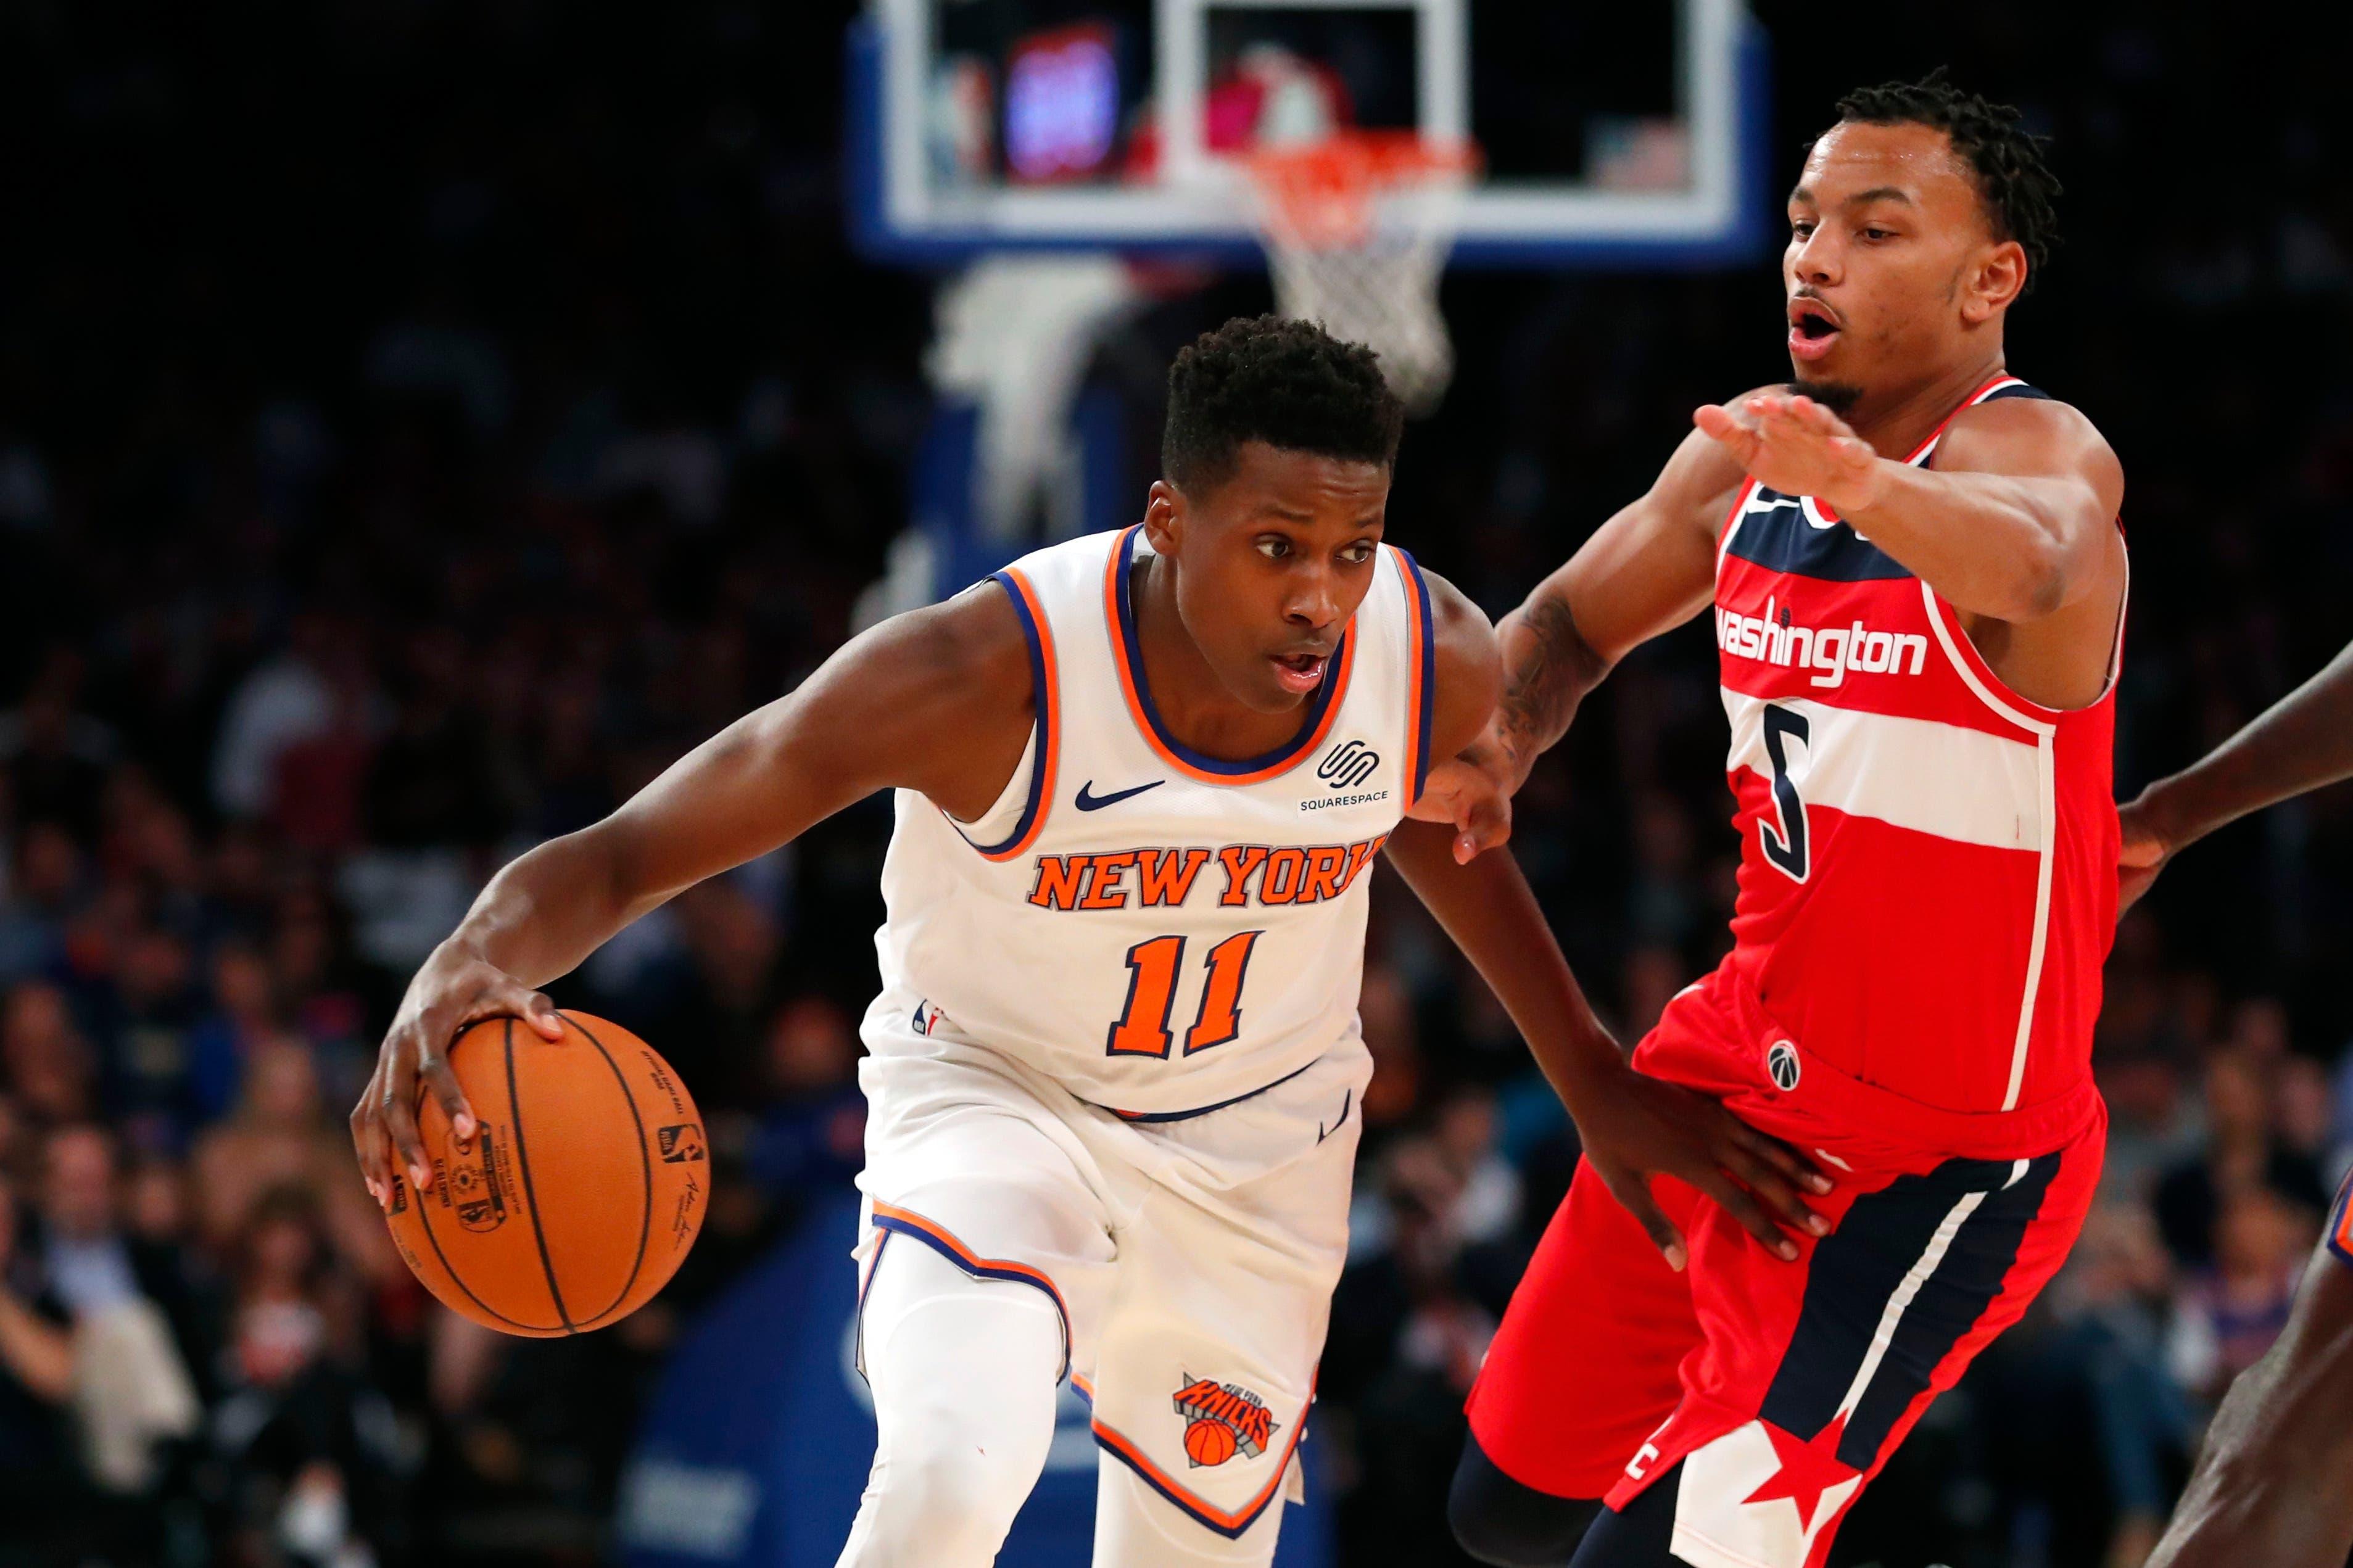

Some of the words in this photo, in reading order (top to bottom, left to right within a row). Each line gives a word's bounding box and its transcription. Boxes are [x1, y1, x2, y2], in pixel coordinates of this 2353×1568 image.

[1300, 790, 1389, 812] SQUARESPACE
[1757, 702, 1811, 885] 5
[1025, 846, 1214, 912] NEW
[1215, 830, 1391, 909] YORK
[1106, 930, 1266, 1060] 11
[1172, 1379, 1273, 1455] KNICKS
